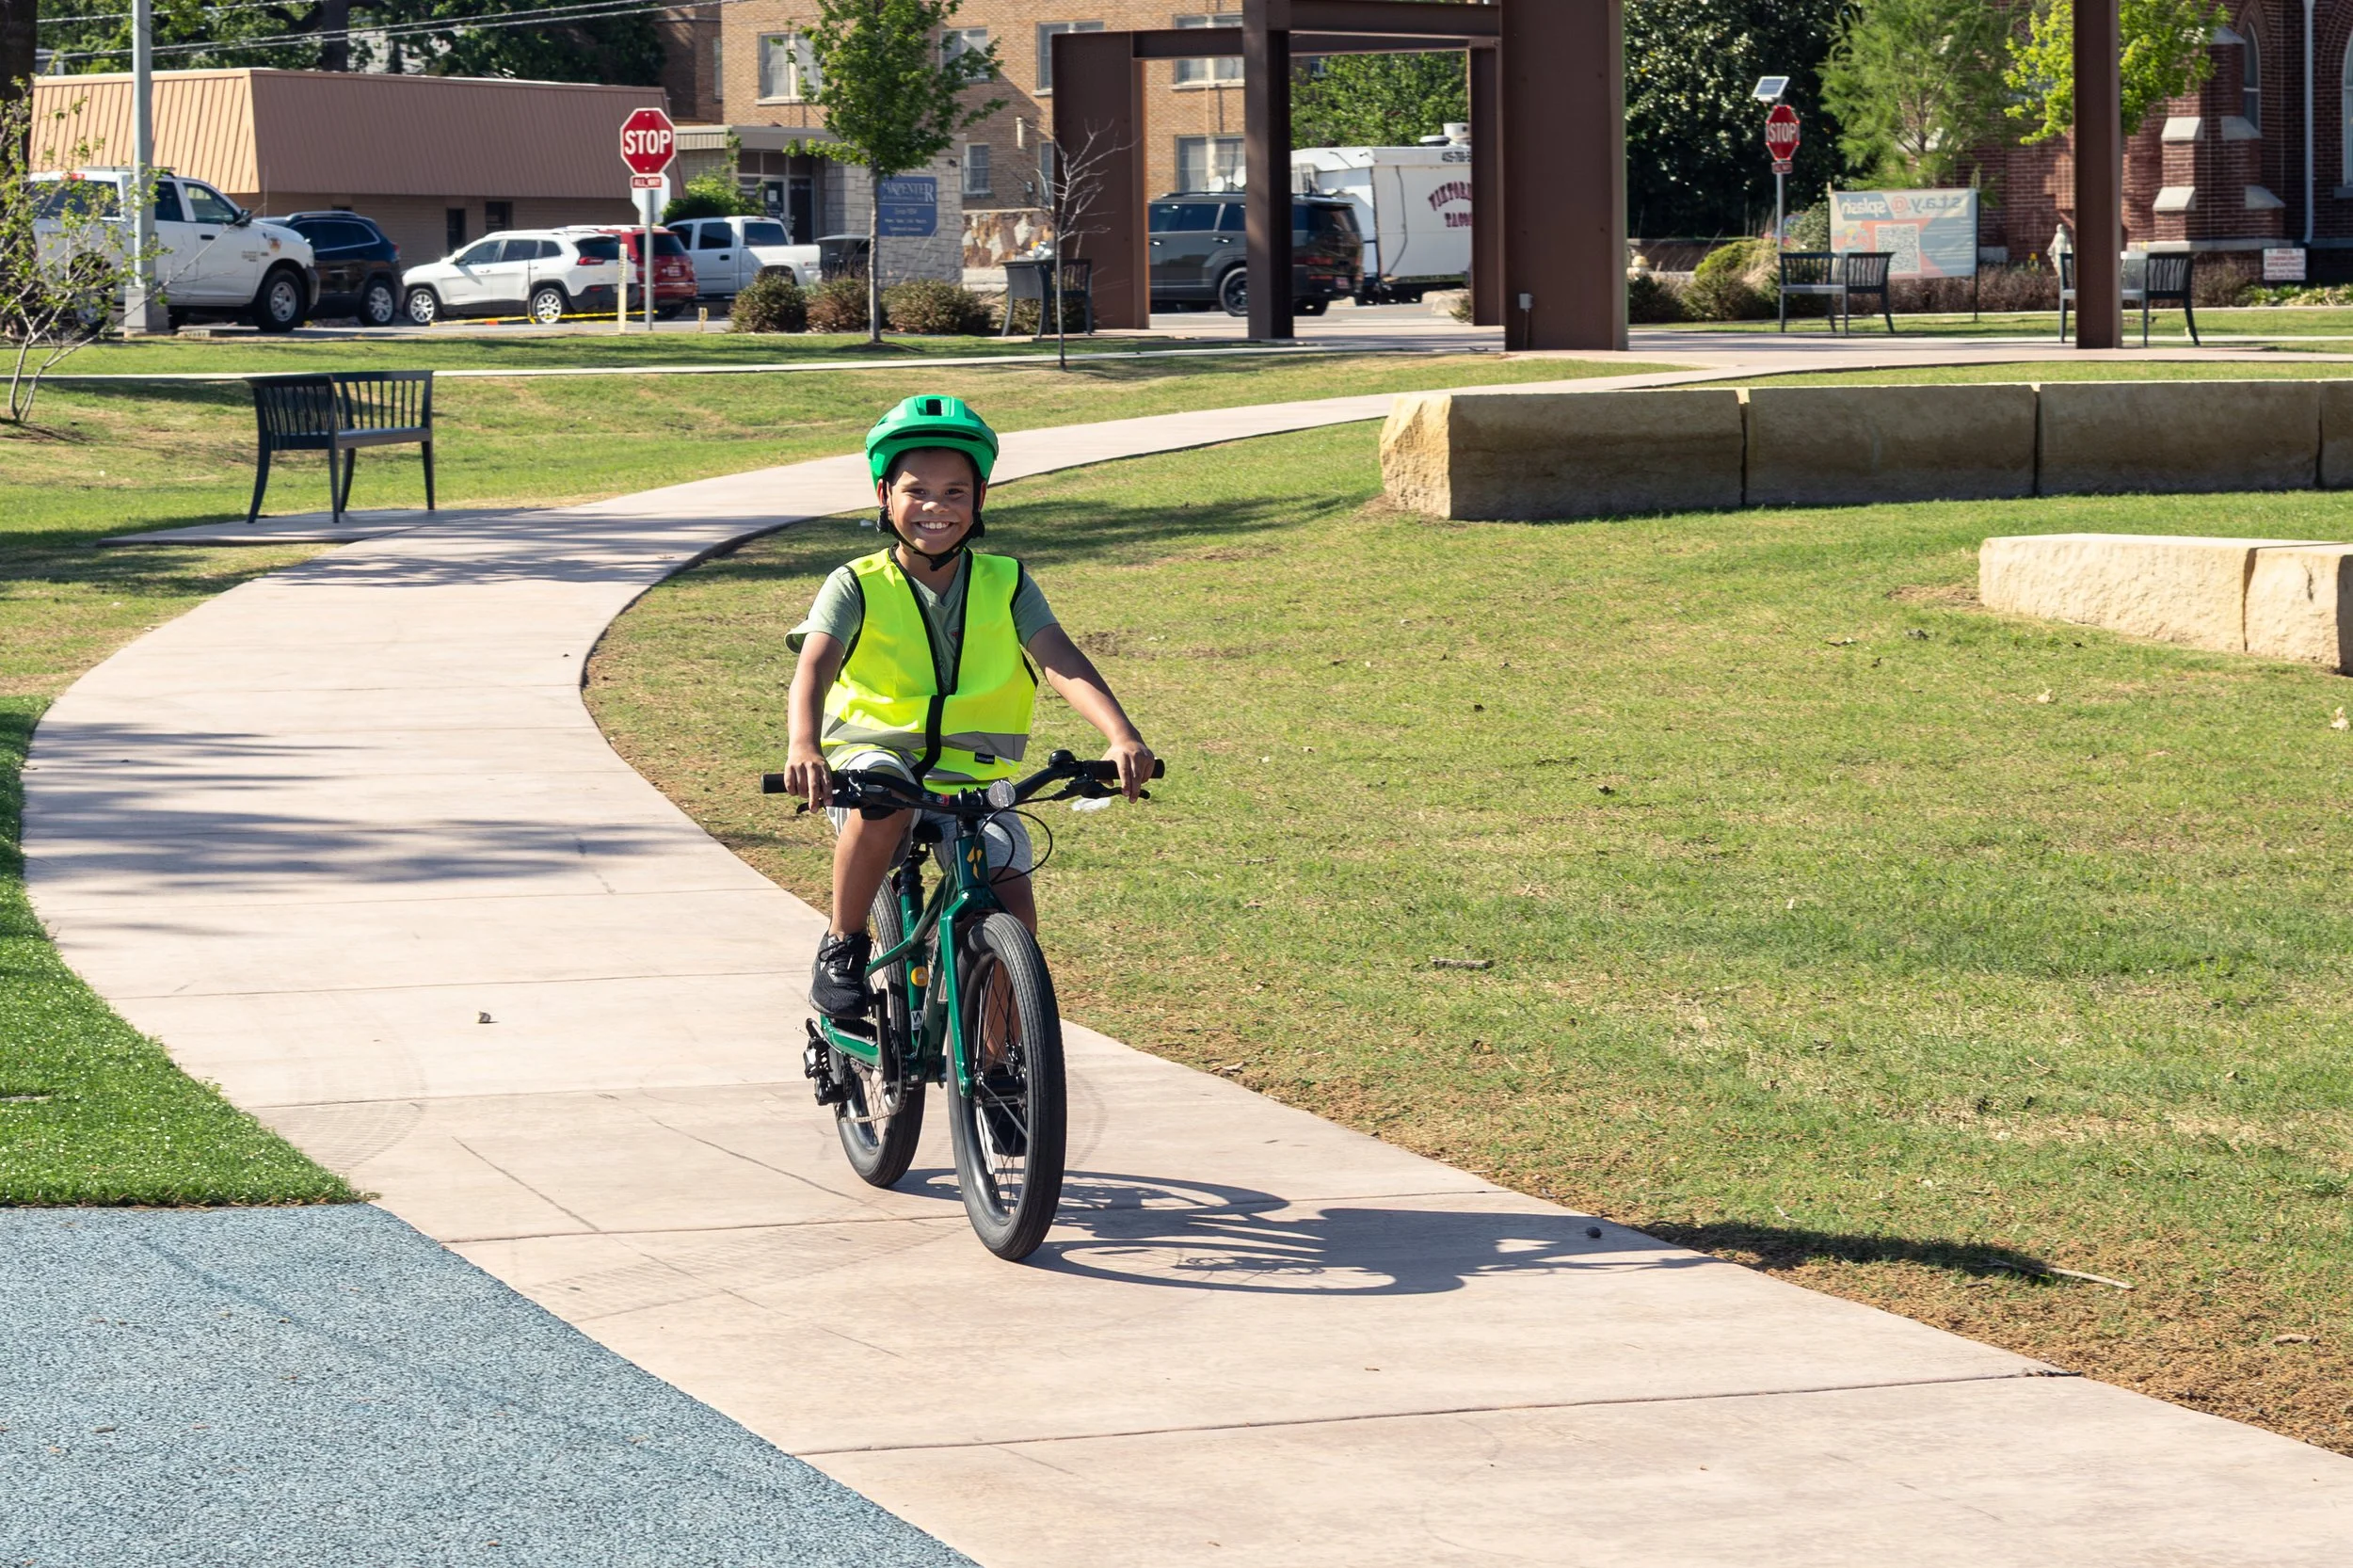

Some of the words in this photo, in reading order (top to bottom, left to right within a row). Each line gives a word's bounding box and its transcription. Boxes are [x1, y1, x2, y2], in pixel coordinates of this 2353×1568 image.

[624, 130, 671, 155] STOP
[1769, 122, 1796, 143] STOP
[634, 178, 647, 186] ALL
